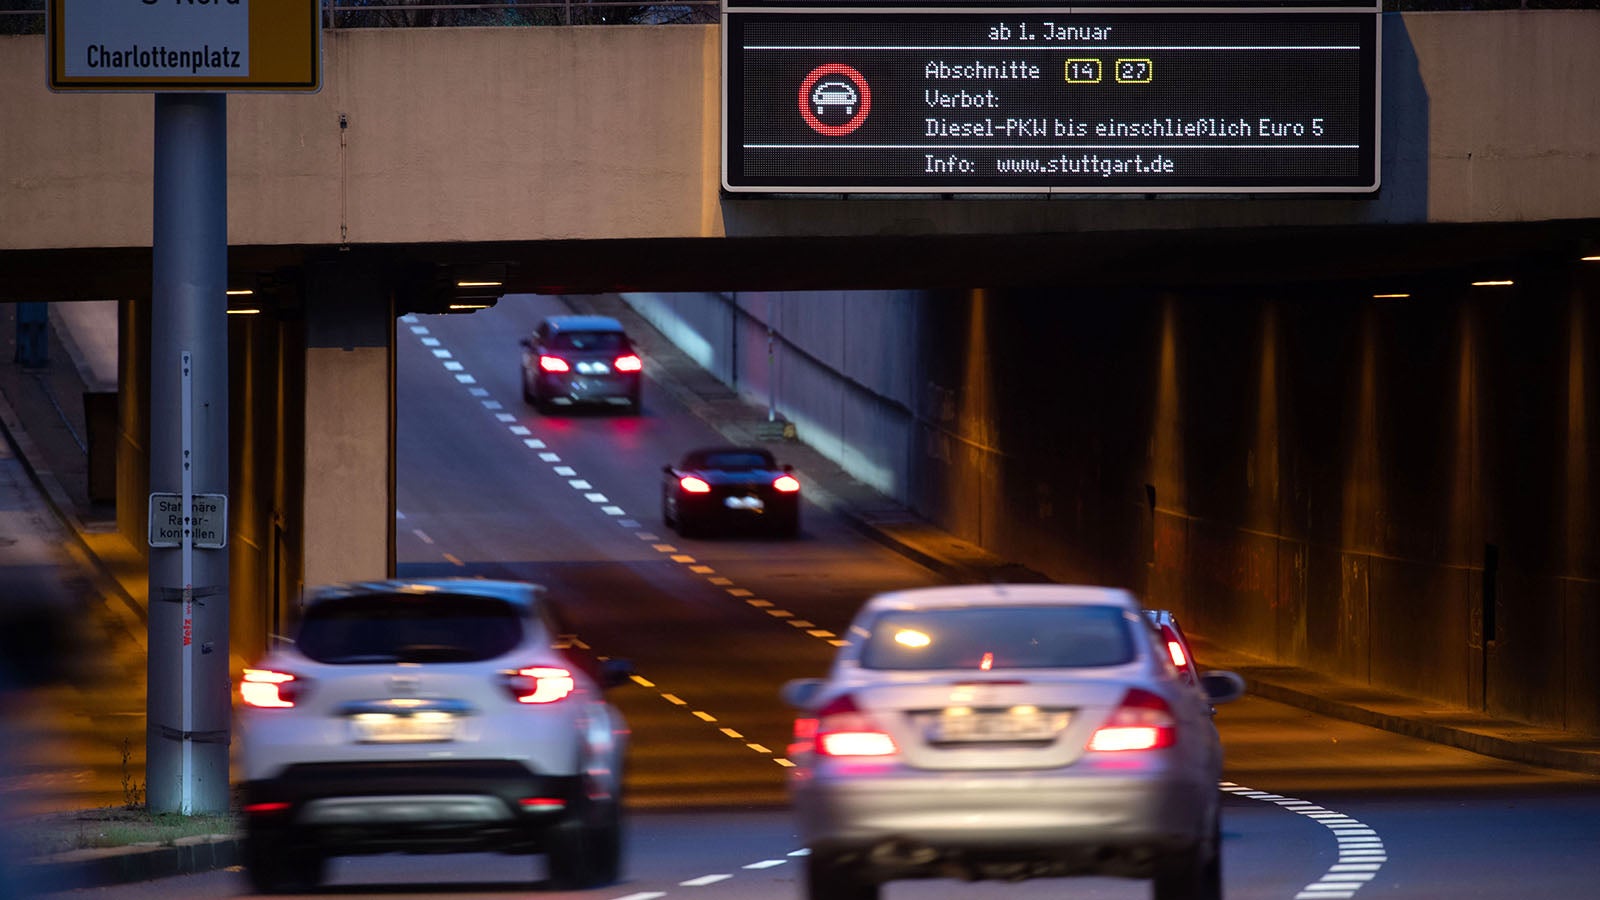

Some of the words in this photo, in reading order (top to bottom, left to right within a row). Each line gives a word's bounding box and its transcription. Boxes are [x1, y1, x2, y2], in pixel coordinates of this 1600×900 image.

[988, 22, 1011, 40] ab
[1019, 22, 1035, 40] 1.
[1043, 22, 1112, 40] Januar
[87, 45, 241, 73] Charlottenplatz
[925, 60, 1040, 79] Abschnitte
[1072, 63, 1093, 79] 14
[1122, 63, 1146, 79] 27
[925, 89, 999, 108] Verbot:
[925, 118, 1047, 137] Diesel-PKW
[1054, 118, 1088, 137] bis
[1095, 118, 1251, 137] einschließlich
[1259, 118, 1304, 137] Euro
[1312, 118, 1324, 137] 5
[925, 154, 975, 173] Info:
[996, 154, 1174, 178] www.stuttgart.de
[160, 501, 217, 513] Statnäre
[168, 514, 209, 526] Raar-
[160, 527, 215, 539] kontllen
